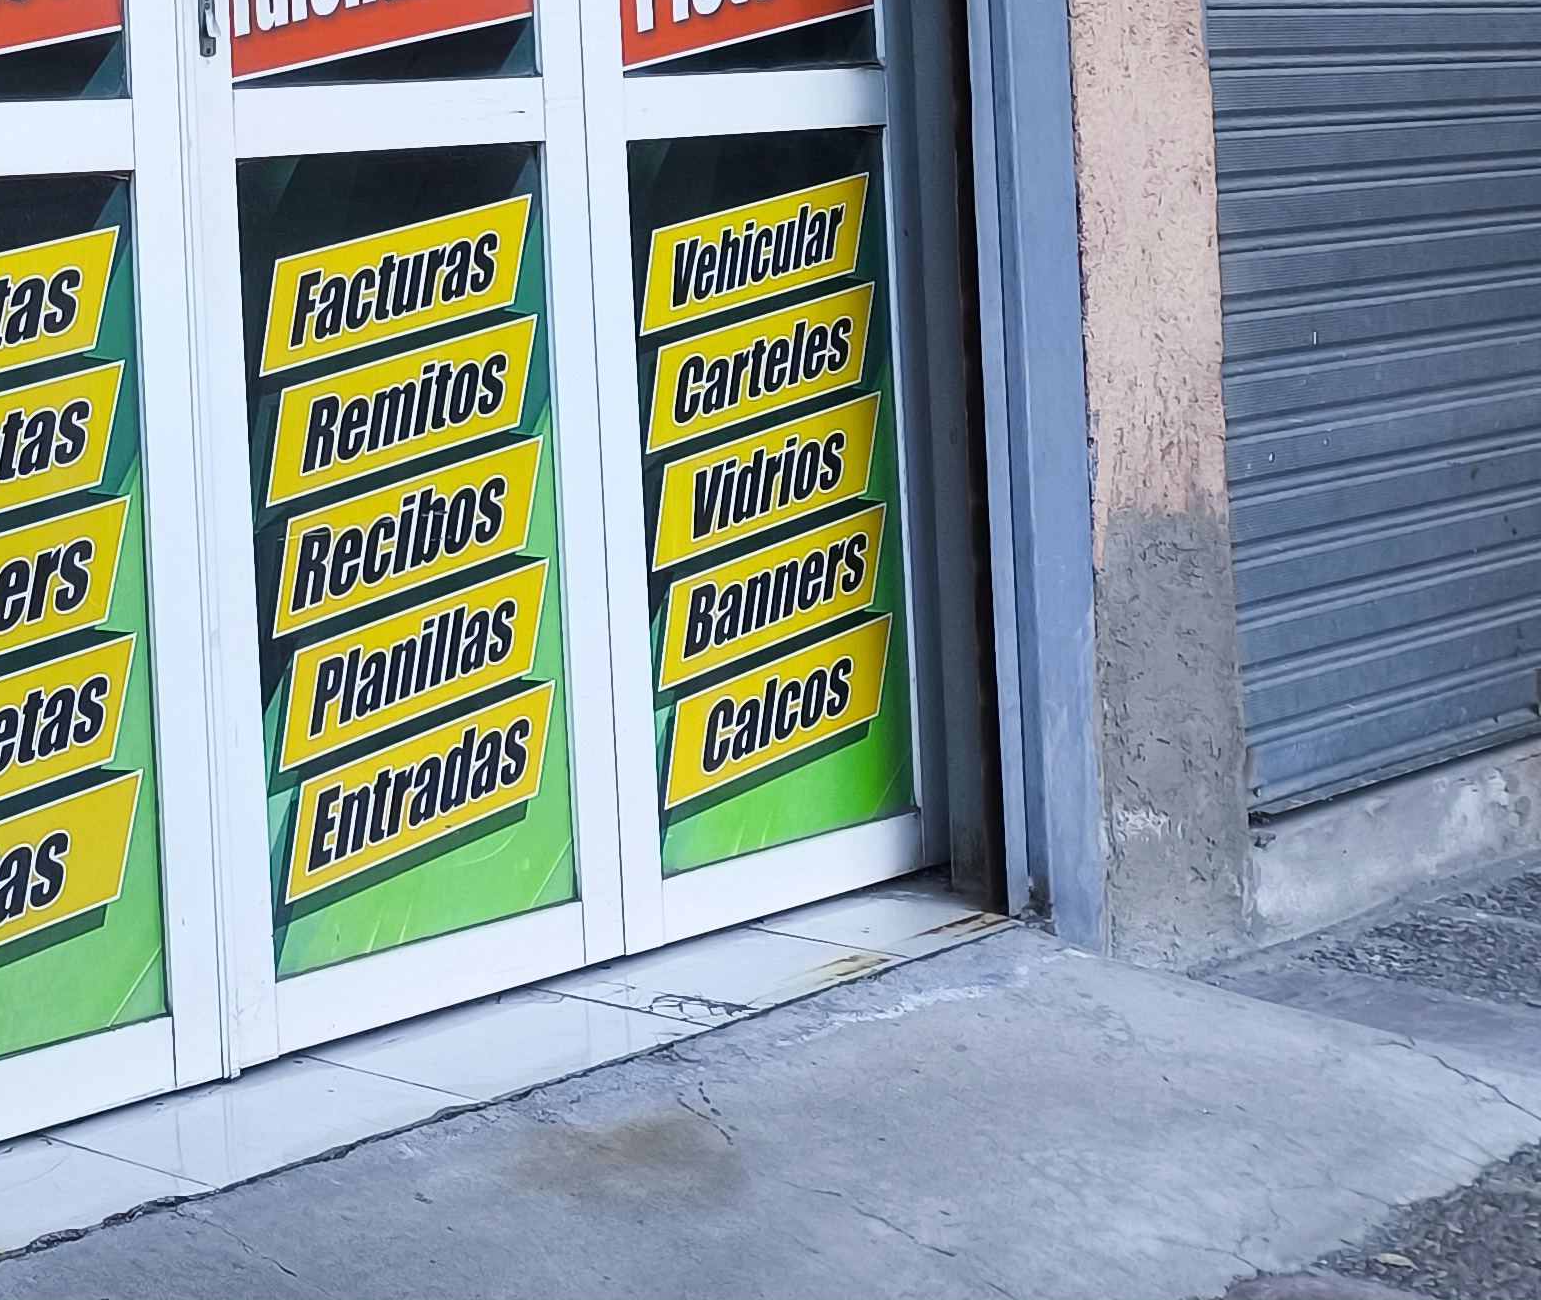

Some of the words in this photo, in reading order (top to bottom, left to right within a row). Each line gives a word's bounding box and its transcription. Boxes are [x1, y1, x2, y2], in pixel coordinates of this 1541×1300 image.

[288, 230, 499, 350] Facturas
[670, 202, 845, 310] Vehicular
[300, 351, 507, 476] Remitos
[672, 315, 853, 425] Carteles
[289, 475, 506, 615] Recibos
[691, 430, 845, 542] Vidrios
[682, 532, 867, 662] Banners
[307, 599, 516, 739] Planillas
[701, 656, 853, 775] Calcos
[306, 716, 531, 874] Entradas
